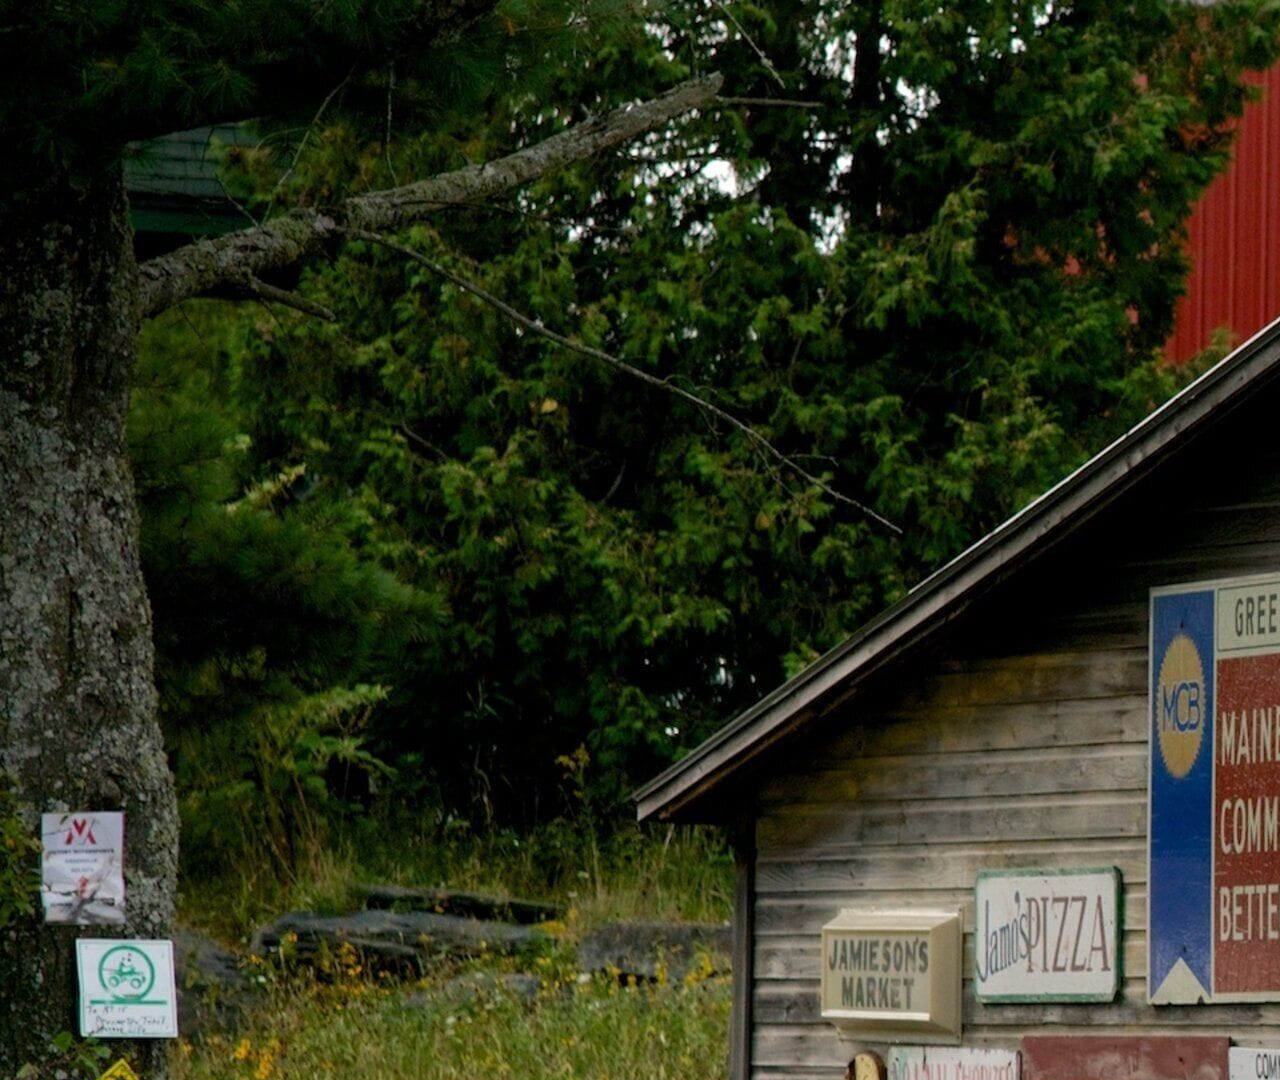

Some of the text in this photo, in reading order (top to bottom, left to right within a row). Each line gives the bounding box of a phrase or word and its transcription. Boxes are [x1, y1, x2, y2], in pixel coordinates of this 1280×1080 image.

[1162, 681, 1201, 735] MCB
[828, 937, 930, 976] JAMIESON'S
[1025, 894, 1112, 975] PIZZA
[841, 976, 916, 1011] MARKET
